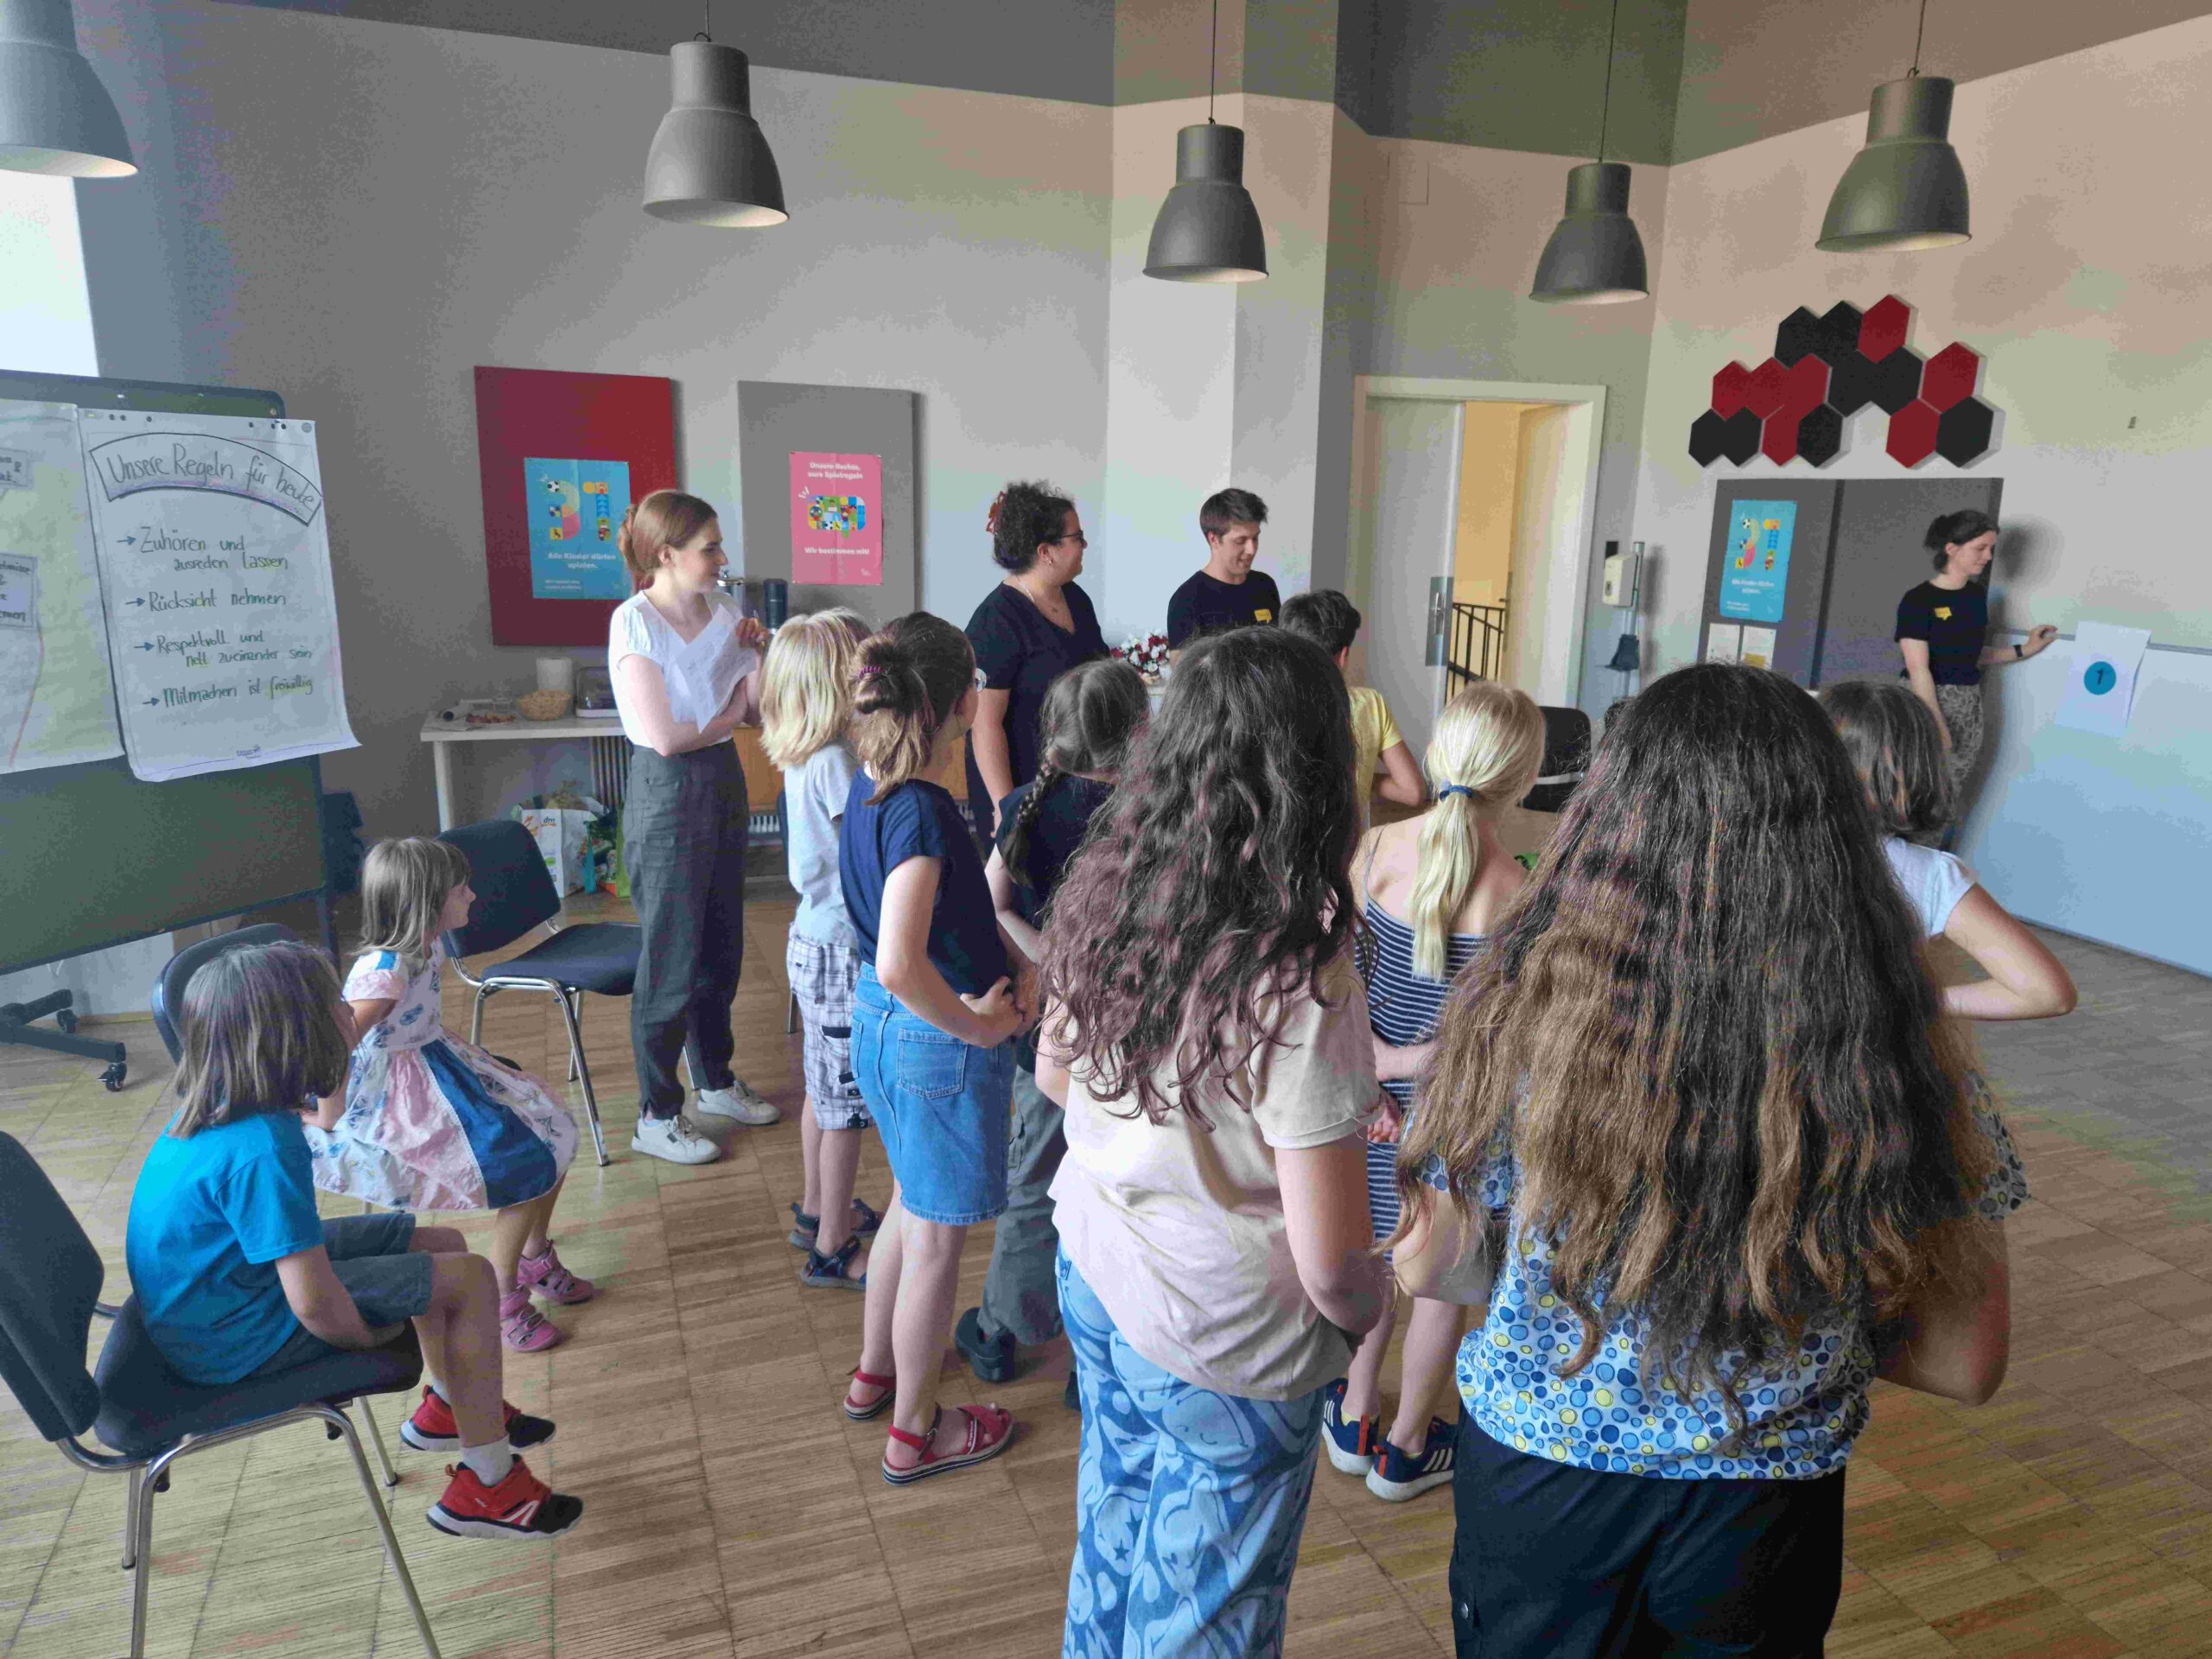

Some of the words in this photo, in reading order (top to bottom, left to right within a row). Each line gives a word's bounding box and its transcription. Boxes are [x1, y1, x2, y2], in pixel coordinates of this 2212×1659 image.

[106, 454, 170, 484] Unsere
[173, 443, 234, 486] Regeln
[245, 455, 268, 491] für
[276, 467, 315, 512] heute
[140, 526, 207, 553] Zuhören
[219, 535, 245, 550] und
[174, 556, 228, 571] ausreden
[149, 588, 217, 612] Rücksicht
[231, 588, 287, 606] nehmen
[156, 629, 229, 656] Respektvoll
[239, 630, 264, 643] und
[186, 652, 209, 667] nett
[219, 648, 278, 664] zueinander
[289, 645, 312, 658] sein
[162, 684, 237, 708] Mitmachen
[248, 677, 262, 695] ist
